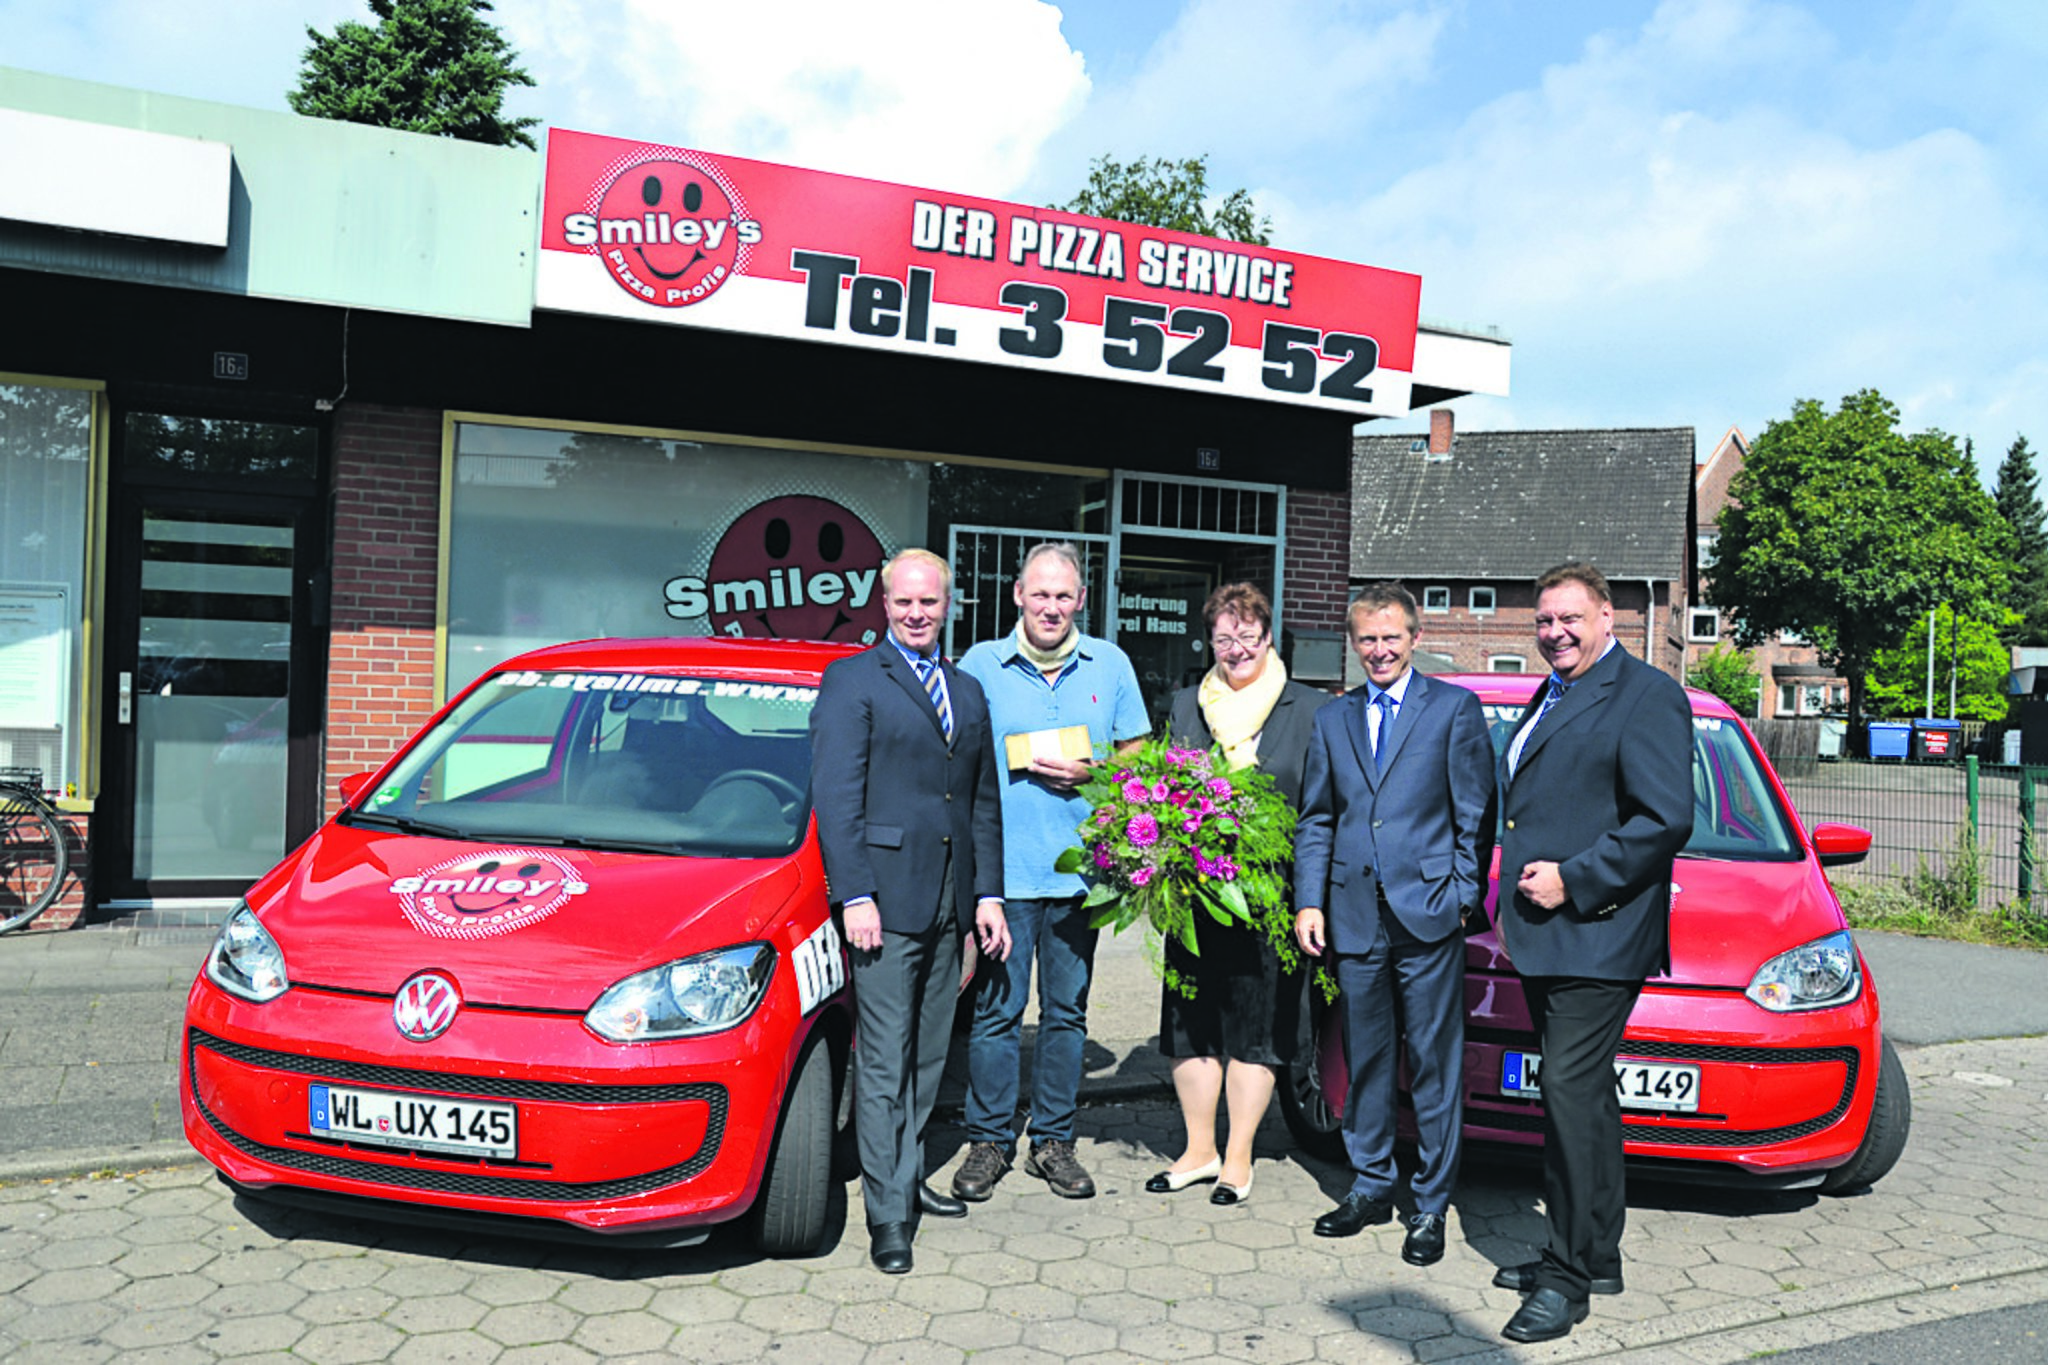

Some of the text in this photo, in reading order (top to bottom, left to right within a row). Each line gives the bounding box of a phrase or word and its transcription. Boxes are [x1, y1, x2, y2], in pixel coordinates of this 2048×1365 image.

[563, 212, 762, 250] Smiley's
[912, 200, 1294, 306] DER PIZZA SERVICE
[607, 249, 726, 303] Pizza Profis
[791, 249, 1378, 403] Tel. 3 52 52
[1118, 593, 1187, 615] ieferung
[1117, 616, 1187, 634] rei Haus
[389, 876, 589, 898] Smiley's
[421, 896, 456, 925] Pizza
[1524, 1058, 1543, 1088] W
[1634, 1069, 1694, 1099] 149
[316, 1093, 510, 1144] D WL UX 145
